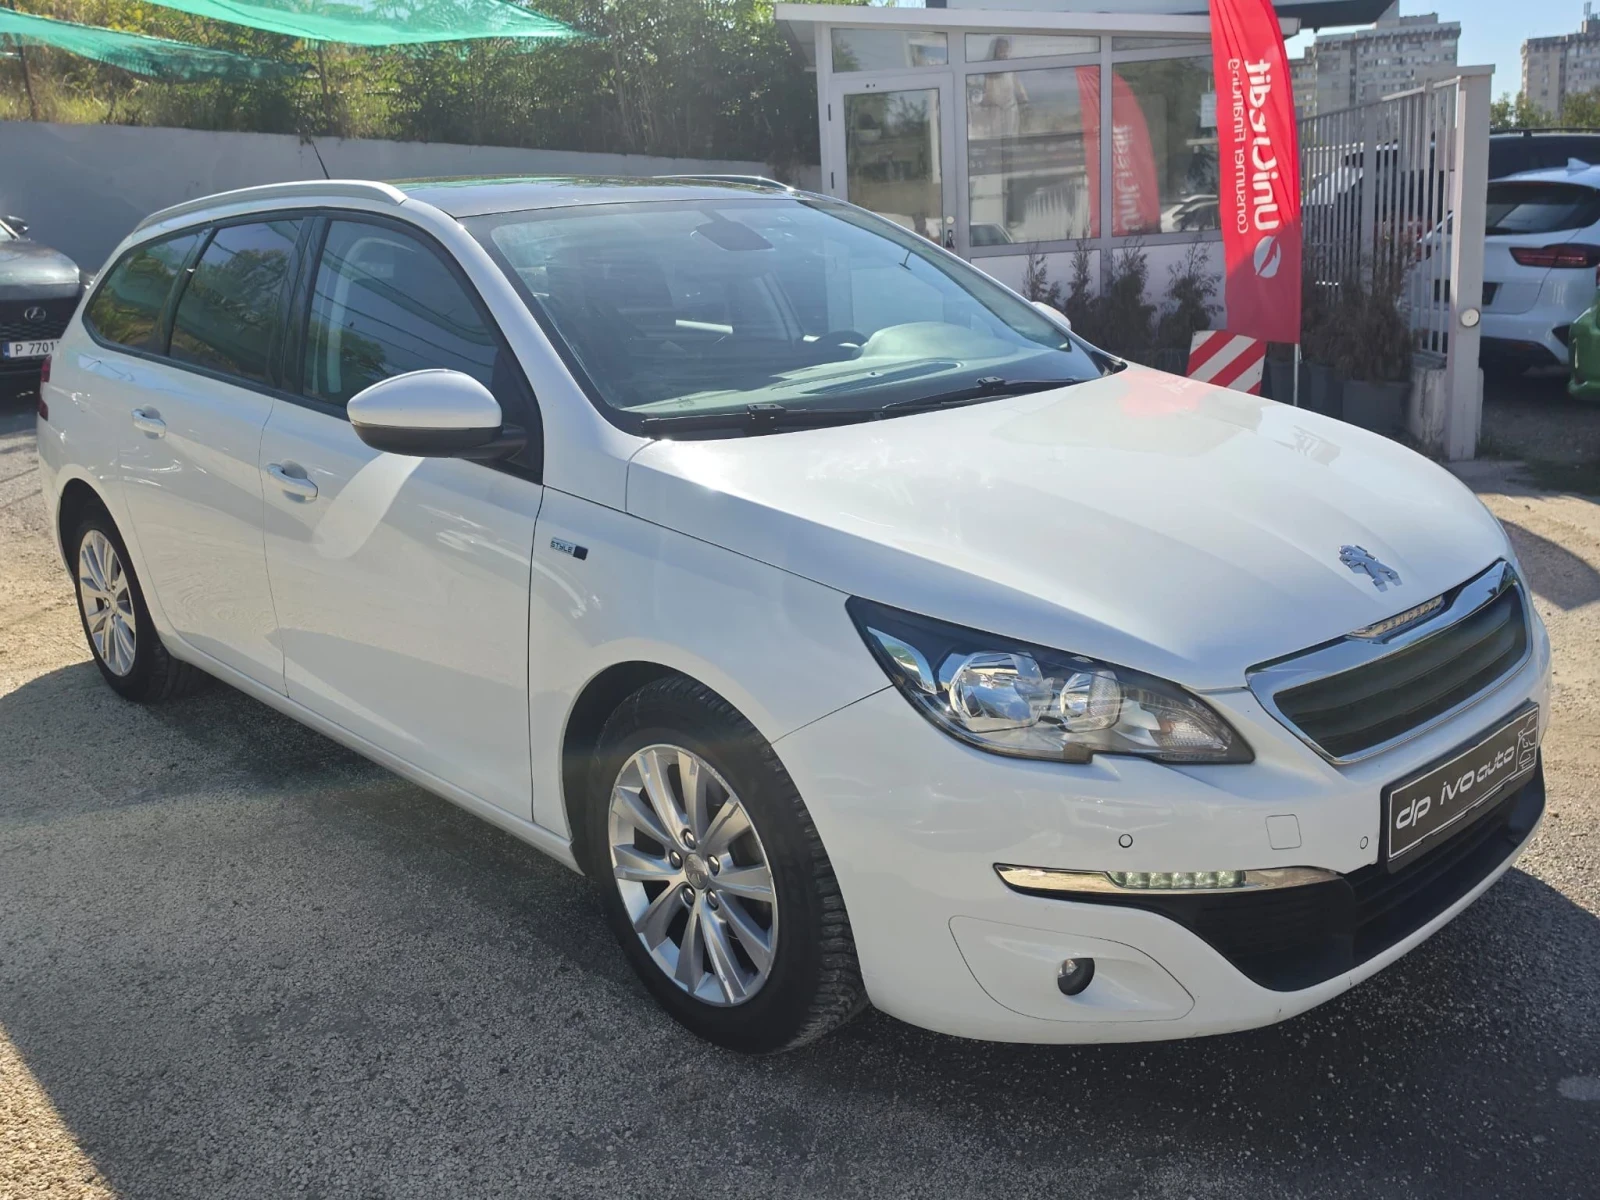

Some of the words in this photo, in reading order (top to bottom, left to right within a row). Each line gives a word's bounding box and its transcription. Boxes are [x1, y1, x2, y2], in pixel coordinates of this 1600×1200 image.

[15, 343, 23, 355] P
[28, 341, 54, 354] 7701
[550, 540, 573, 554] STYLE
[1440, 770, 1475, 805] ivo
[1477, 746, 1514, 782] auto
